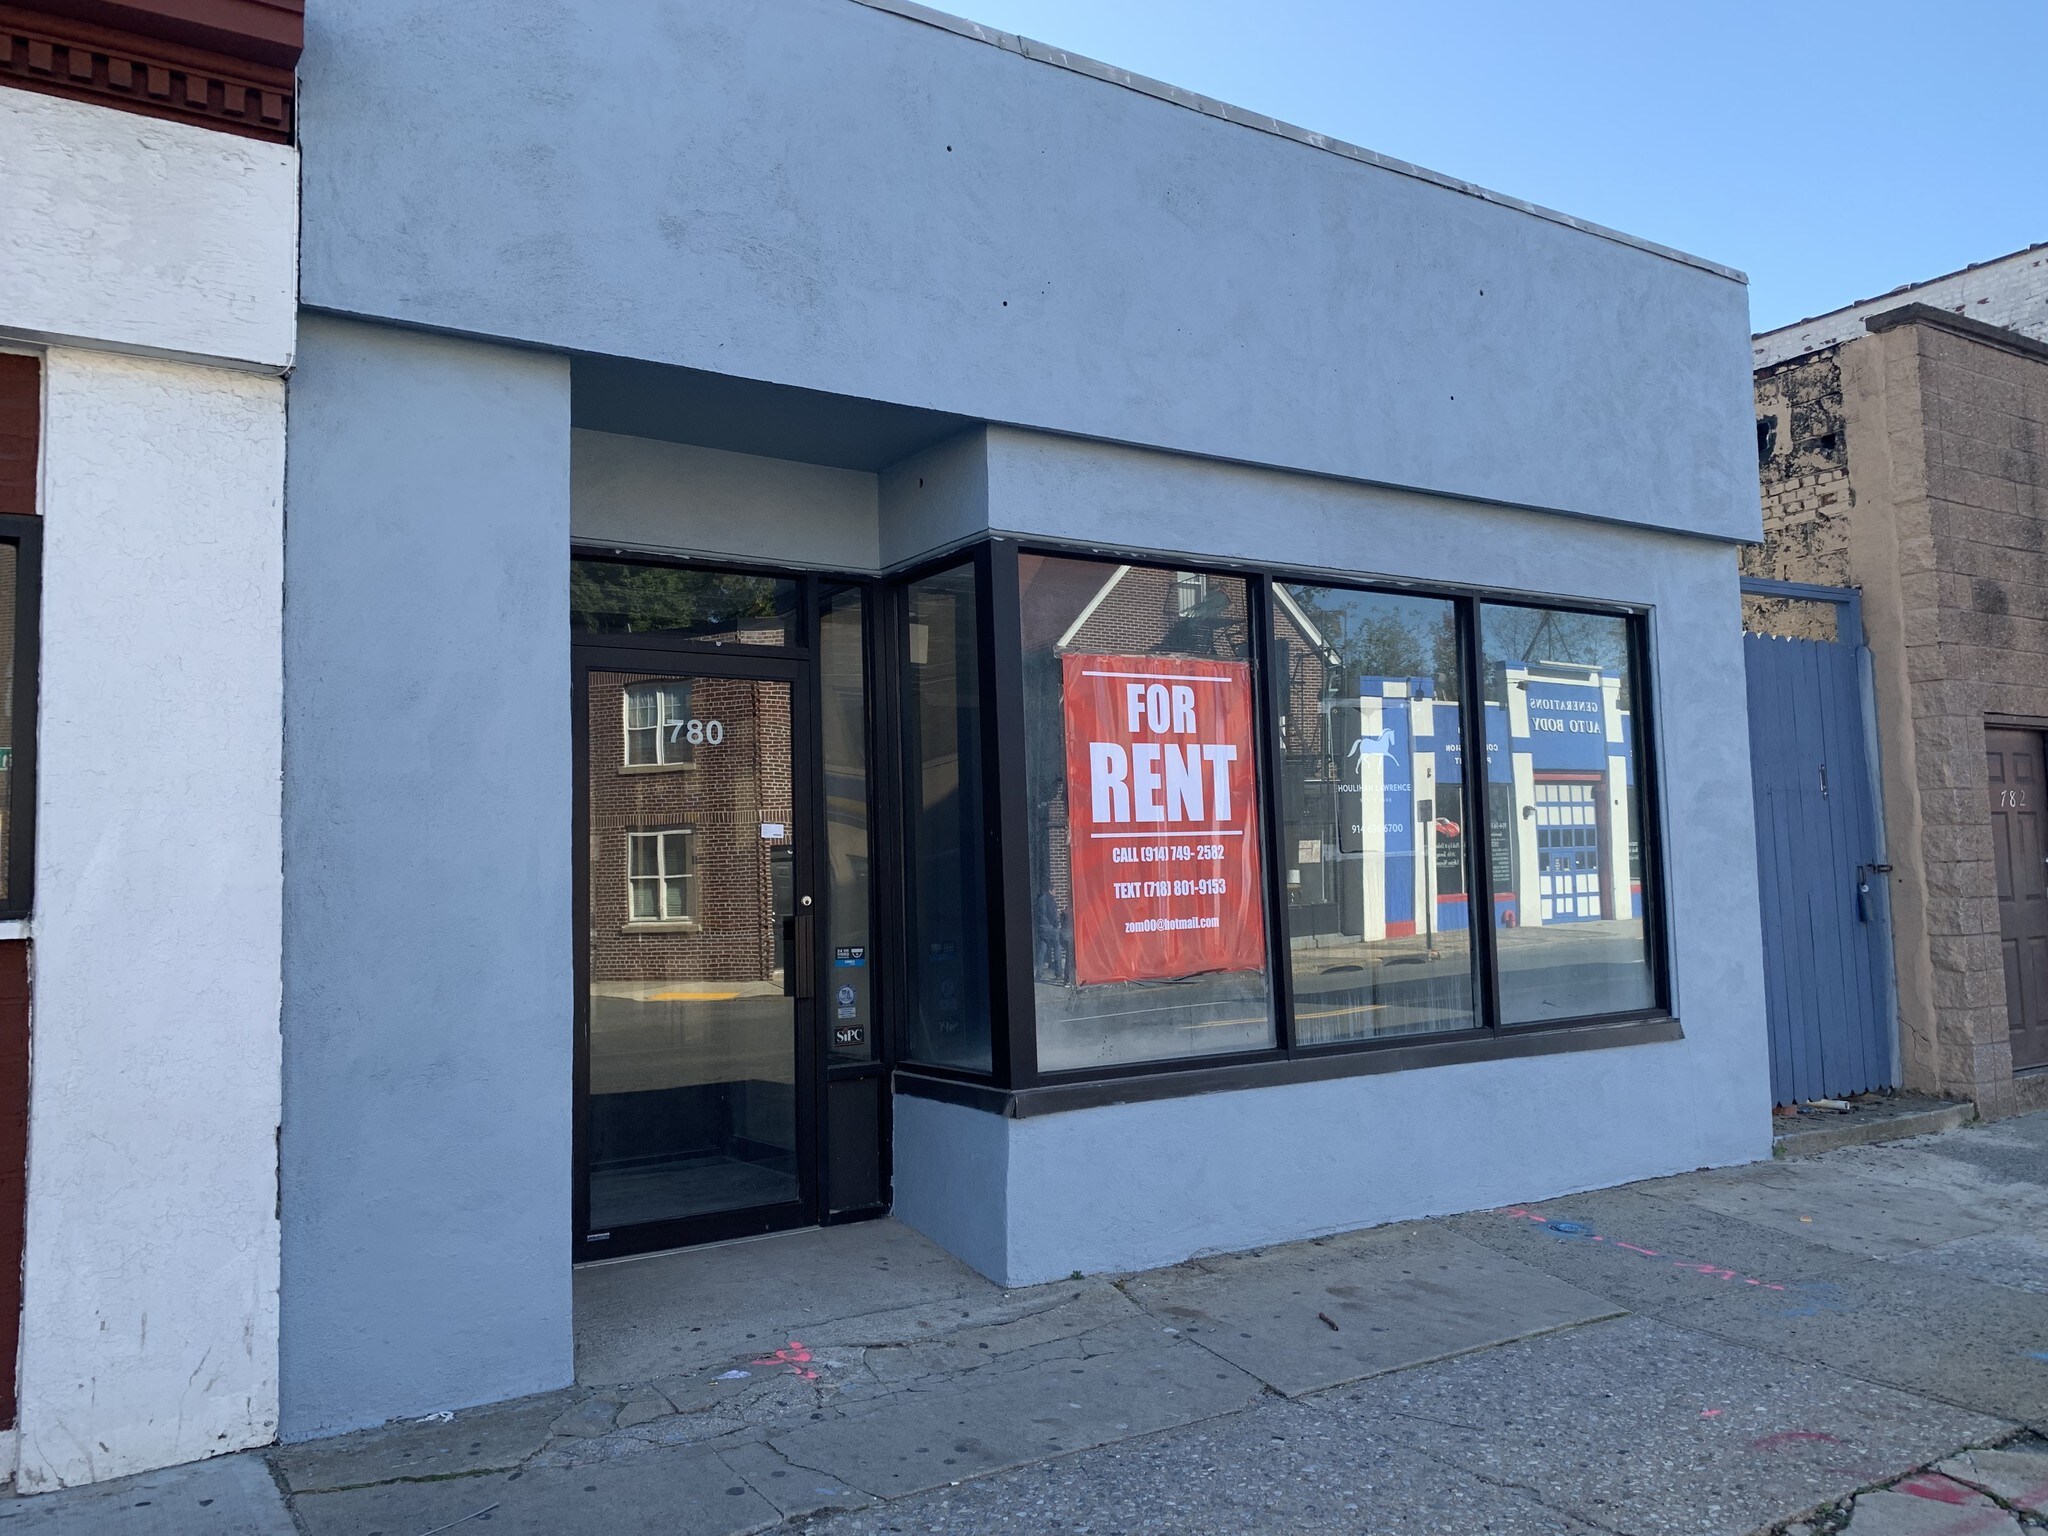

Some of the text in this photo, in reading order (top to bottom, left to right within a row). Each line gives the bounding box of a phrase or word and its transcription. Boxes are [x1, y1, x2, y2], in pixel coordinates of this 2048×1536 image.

[1126, 683, 1197, 734] FOR
[666, 718, 724, 745] 780
[1089, 741, 1238, 824] RENT
[1375, 783, 1412, 792] LAWRENCE
[1112, 846, 1139, 864] CALL
[1141, 845, 1169, 862] (914)
[1197, 844, 1225, 860] 2582
[1113, 878, 1227, 899] TEXT (718) 801-9153
